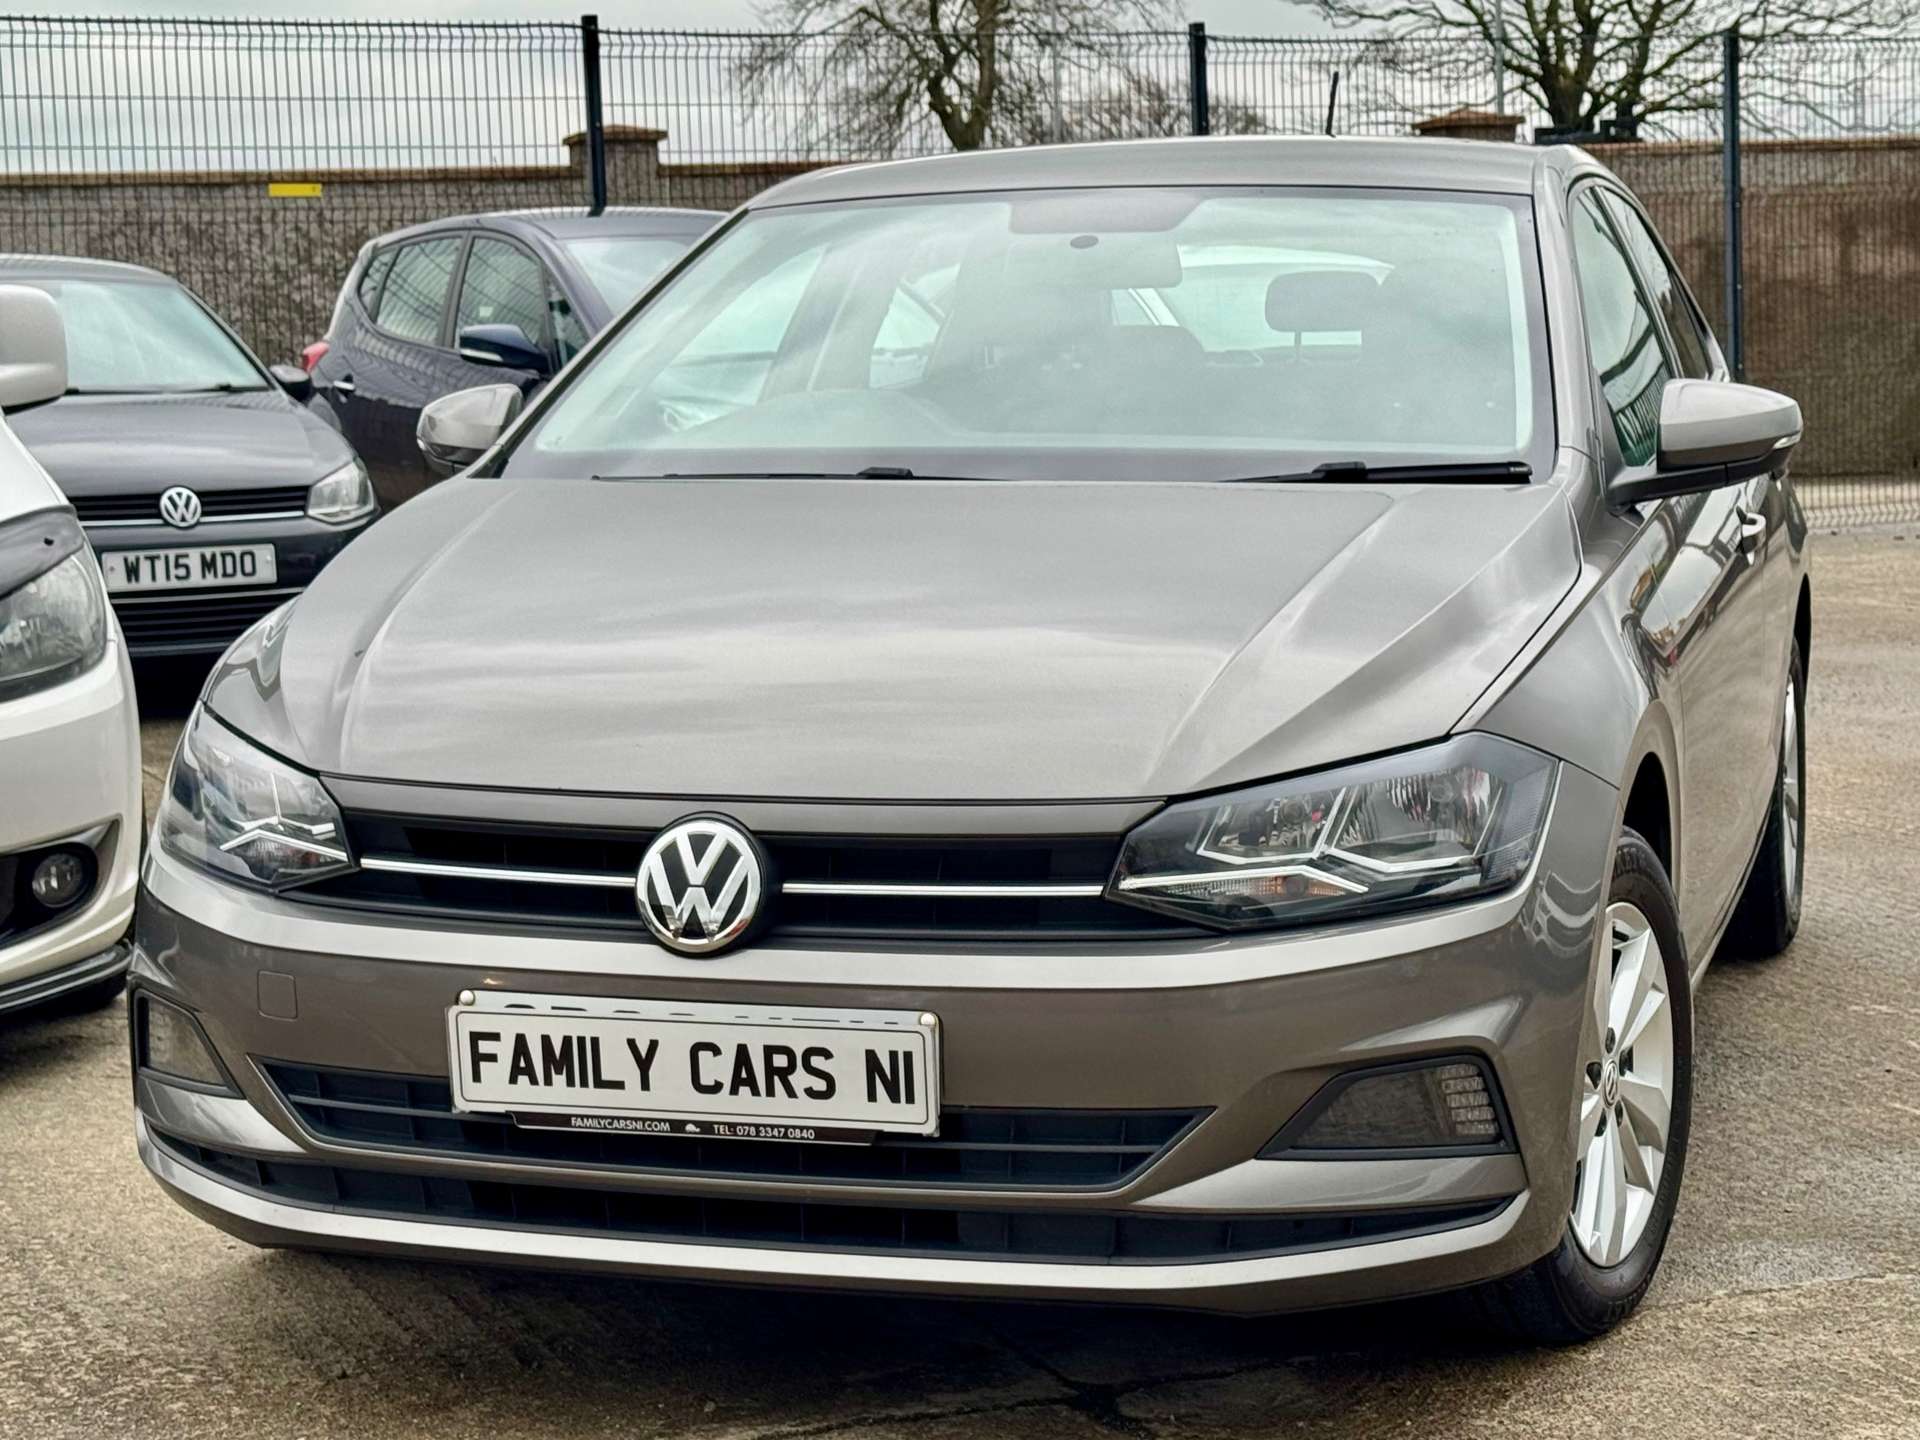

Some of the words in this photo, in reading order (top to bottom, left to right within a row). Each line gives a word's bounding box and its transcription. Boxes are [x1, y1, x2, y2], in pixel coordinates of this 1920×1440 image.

[123, 553, 191, 584] WT15
[201, 550, 257, 580] MDO
[645, 827, 753, 945] VW
[469, 1031, 659, 1092] FAMILY
[689, 1041, 836, 1101] CARS
[865, 1049, 916, 1105] NI
[571, 1116, 670, 1132] FAMILYCARSNI.COM
[736, 1125, 756, 1136] 078
[759, 1126, 785, 1138] 3347
[787, 1128, 816, 1139] 0840
